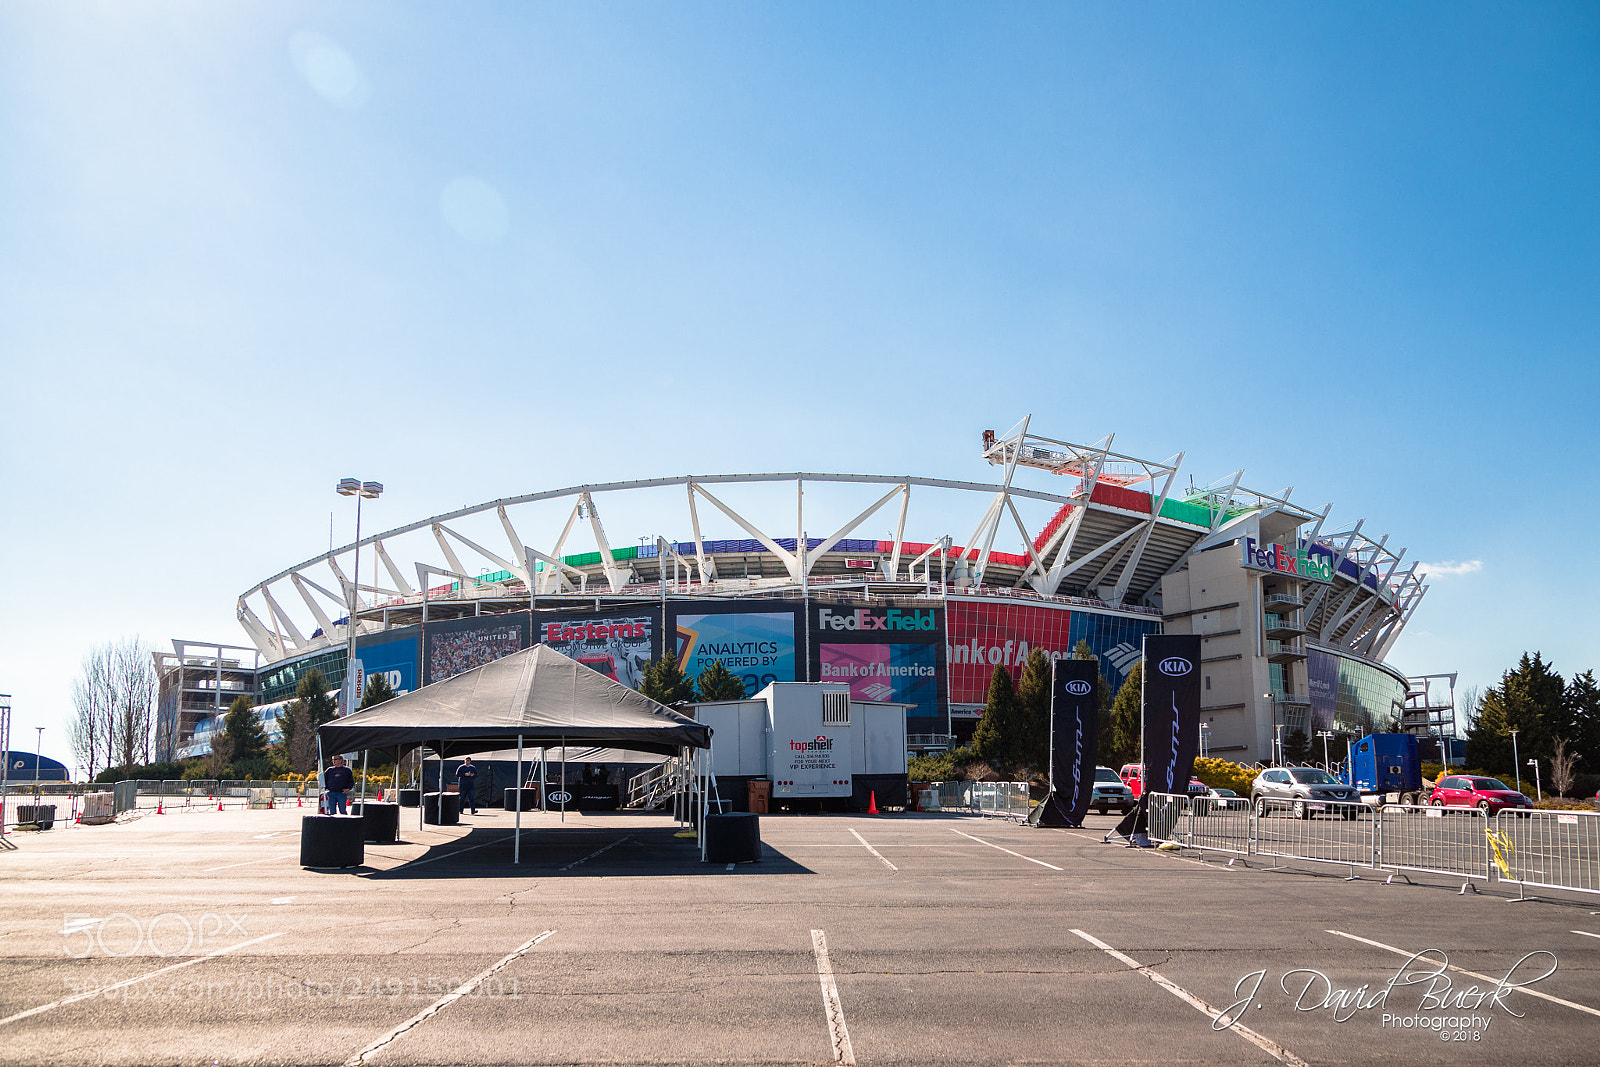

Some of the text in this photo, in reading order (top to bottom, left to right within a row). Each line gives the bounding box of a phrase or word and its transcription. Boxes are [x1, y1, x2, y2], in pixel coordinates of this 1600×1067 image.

[1241, 536, 1332, 581] FedExField
[478, 633, 507, 641] UNITED
[547, 623, 645, 642] Easterns
[697, 641, 778, 655] ANALYTICS
[988, 640, 1013, 666] of
[697, 656, 778, 668] POWERED BY
[1165, 662, 1186, 672] KIA
[822, 663, 935, 677] Bank of America
[1070, 684, 1087, 692] KIA
[789, 739, 833, 753] topshelf
